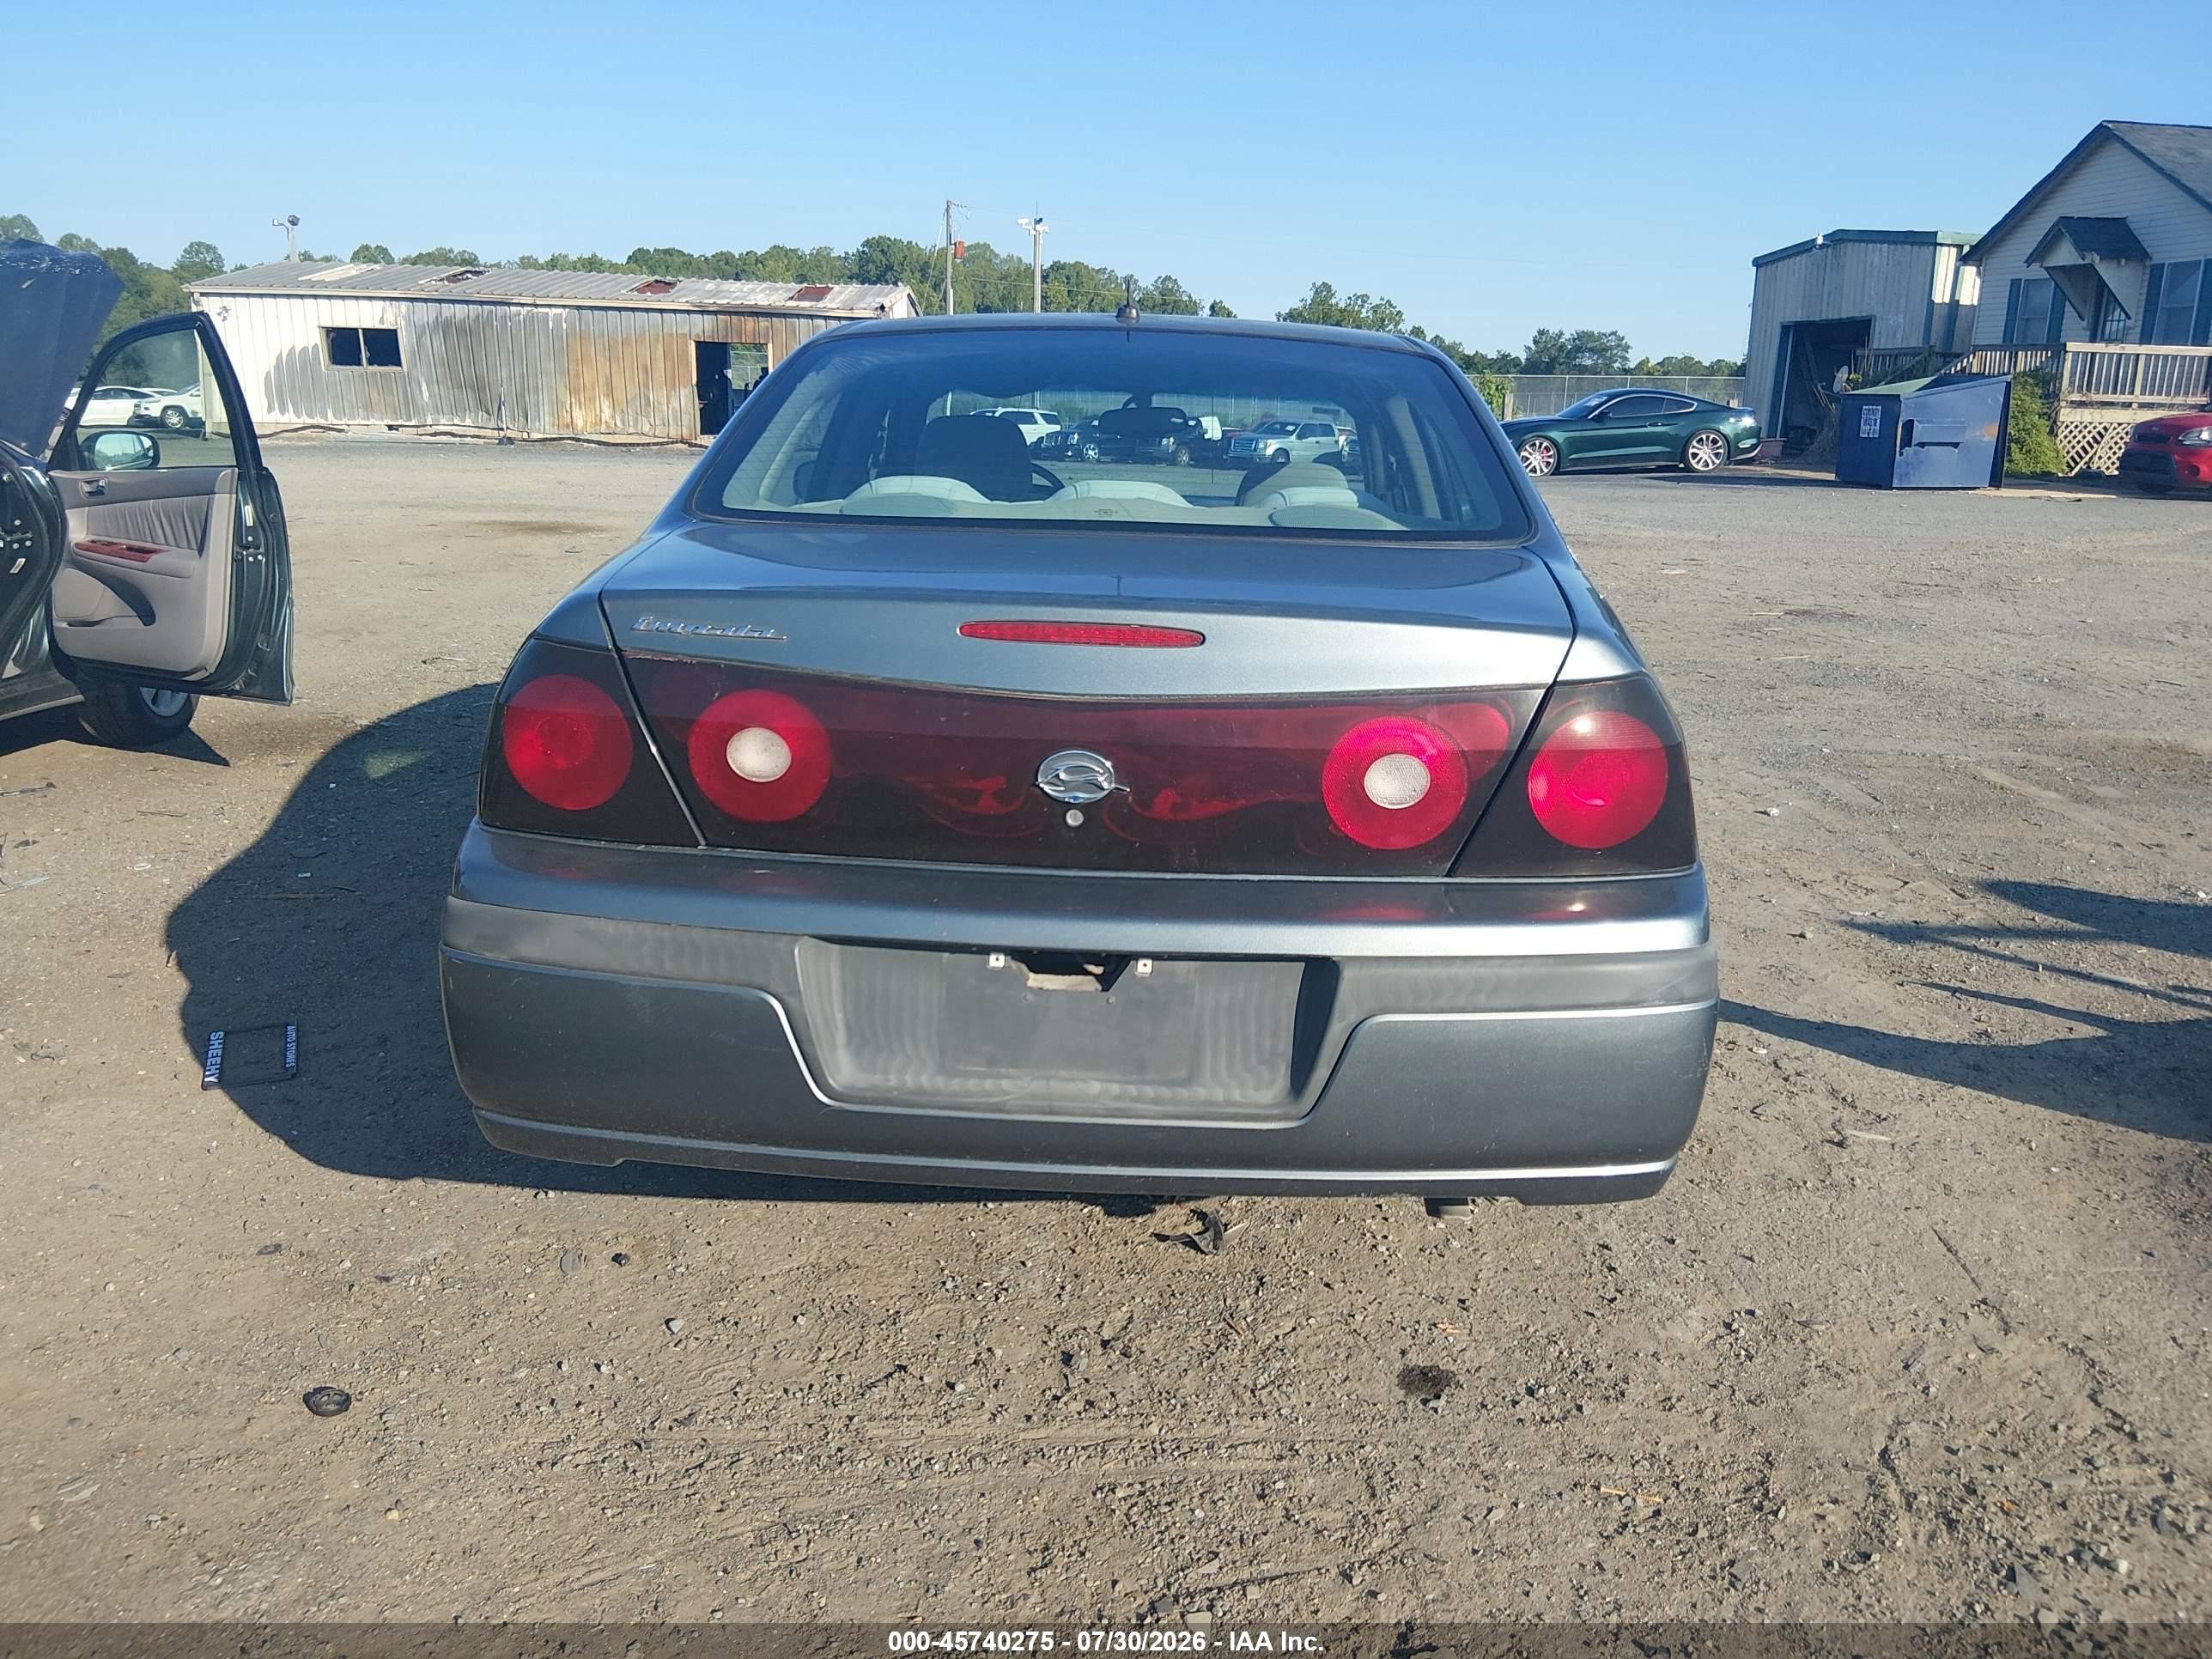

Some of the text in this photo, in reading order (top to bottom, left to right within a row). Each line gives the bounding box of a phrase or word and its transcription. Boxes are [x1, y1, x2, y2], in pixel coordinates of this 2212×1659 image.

[204, 1031, 224, 1083] SHEEHY
[285, 1025, 296, 1067] AUTO STORES
